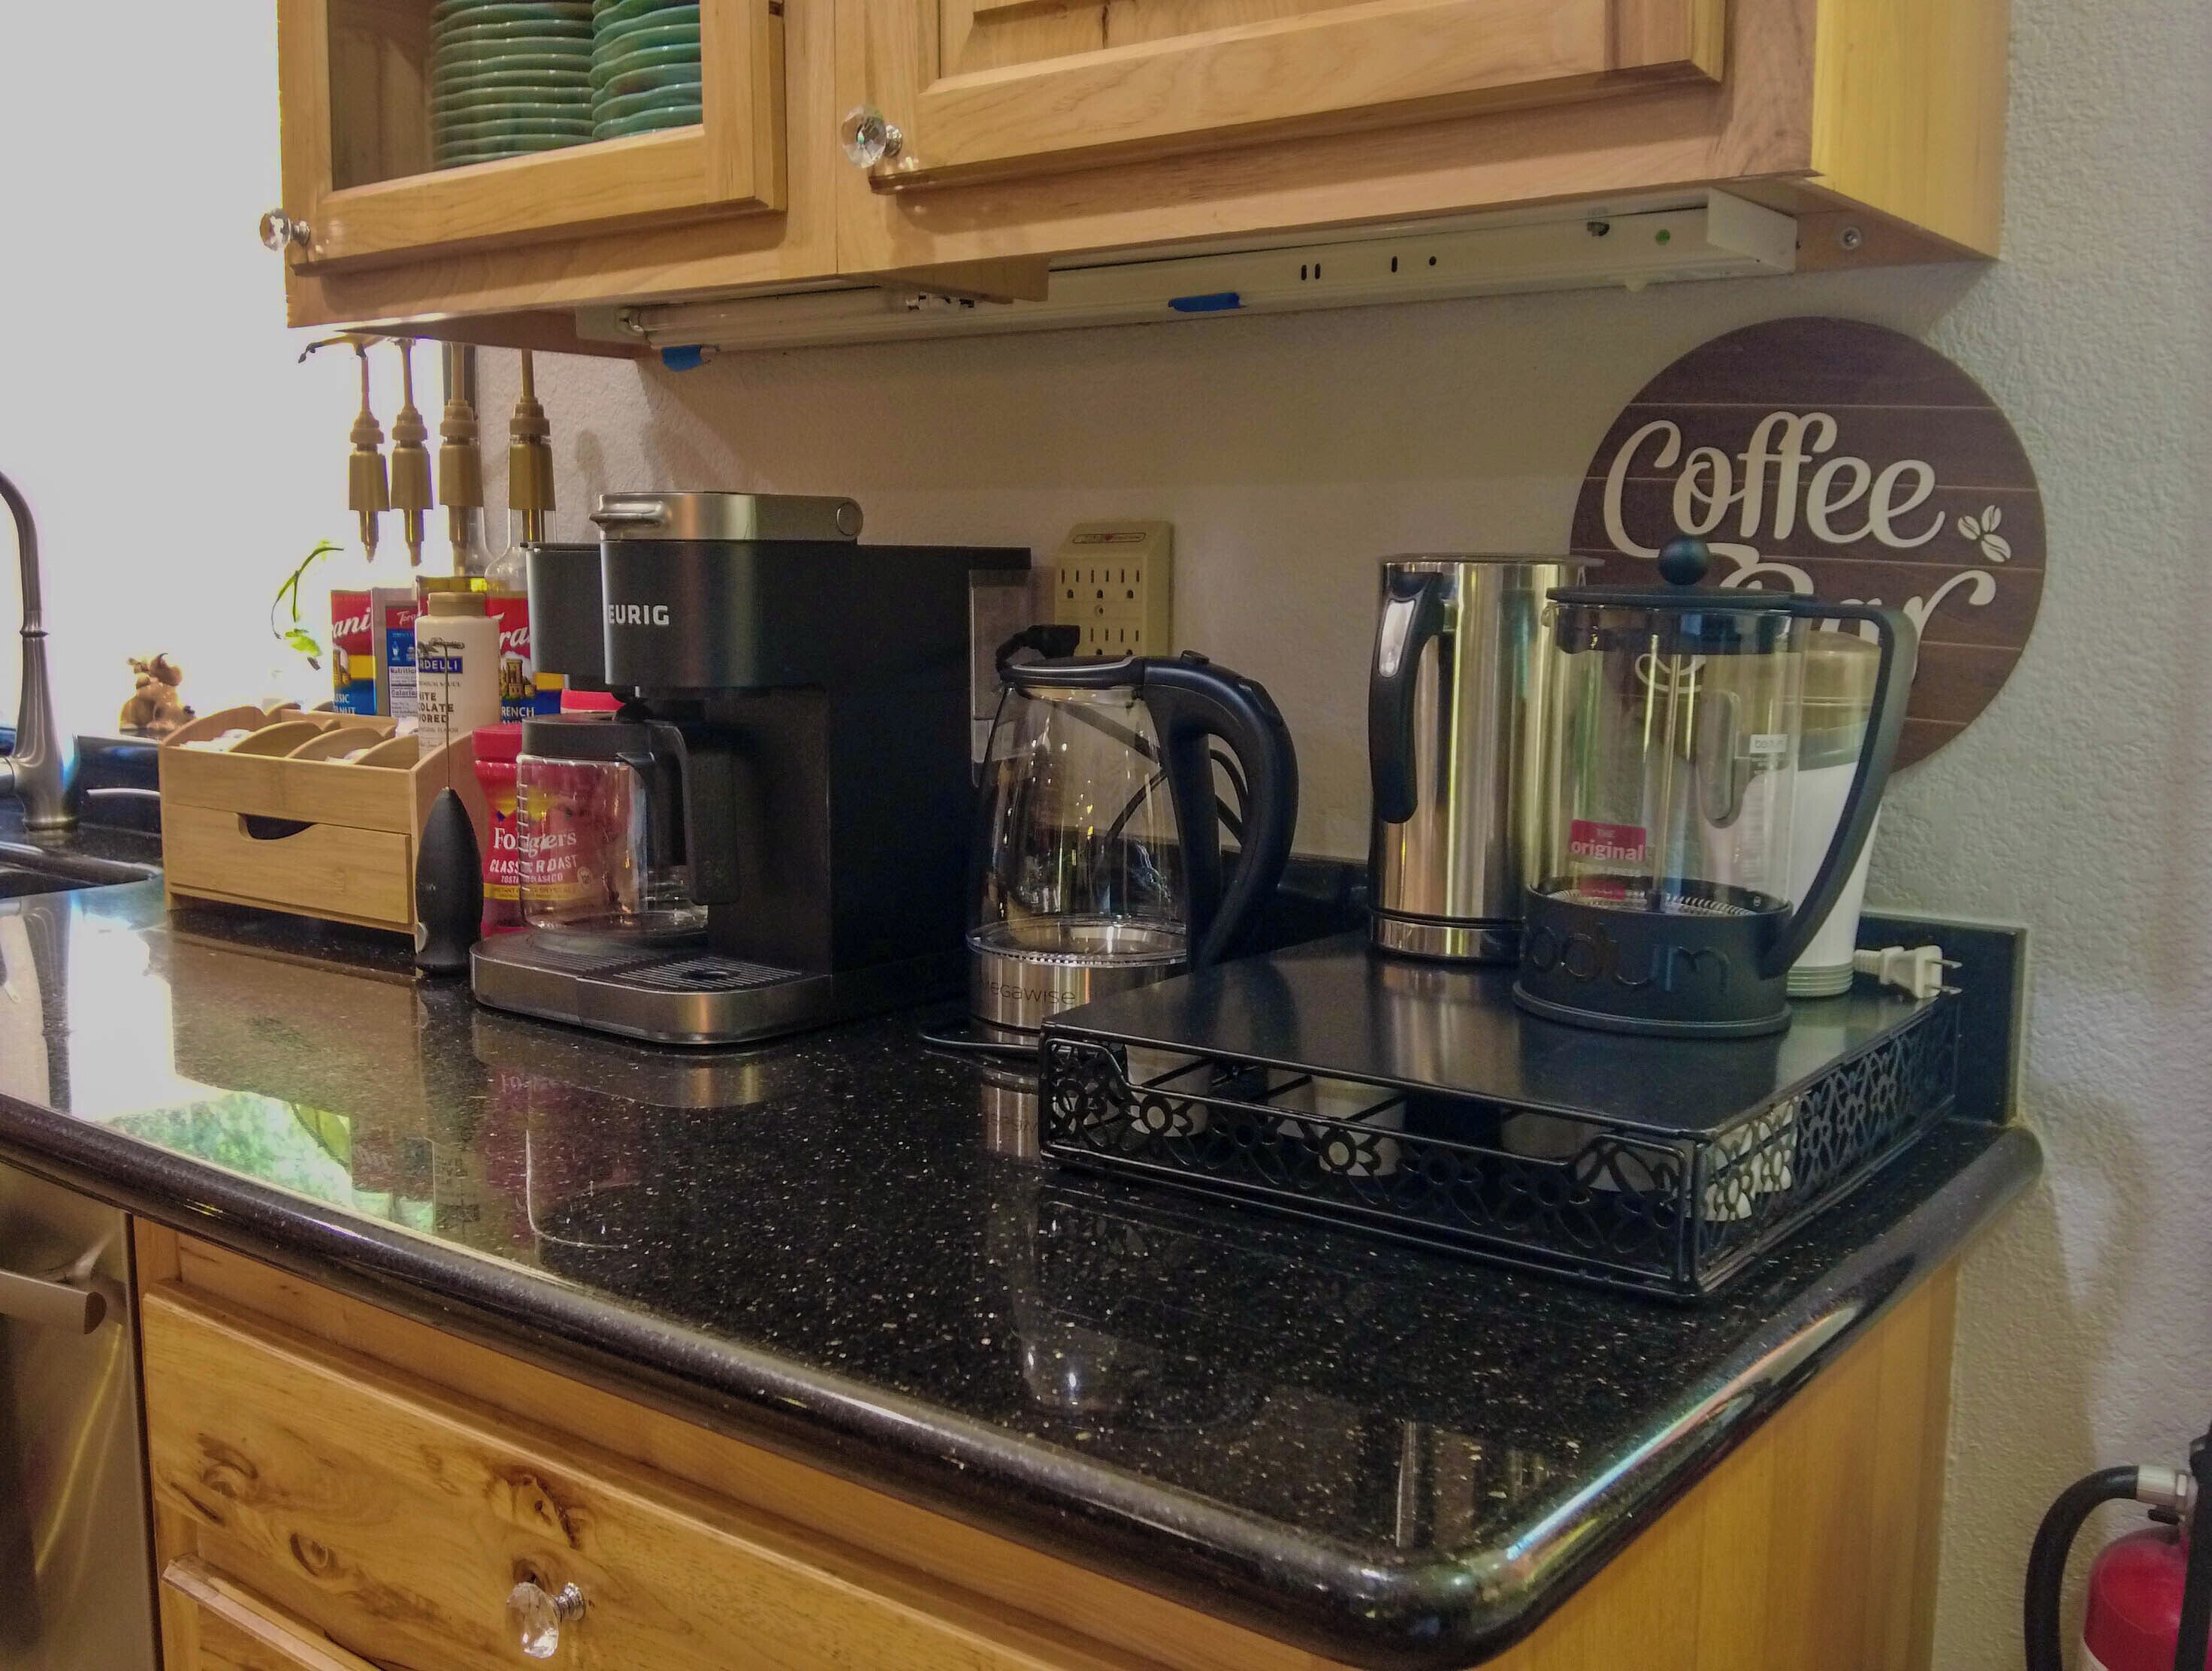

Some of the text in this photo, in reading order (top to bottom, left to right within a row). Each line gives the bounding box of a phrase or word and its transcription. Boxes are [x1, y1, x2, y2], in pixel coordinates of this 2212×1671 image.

[1603, 411, 1945, 558] Coffee
[331, 606, 371, 639] ani
[536, 854, 577, 874] ROAST
[1570, 839, 1645, 863] original
